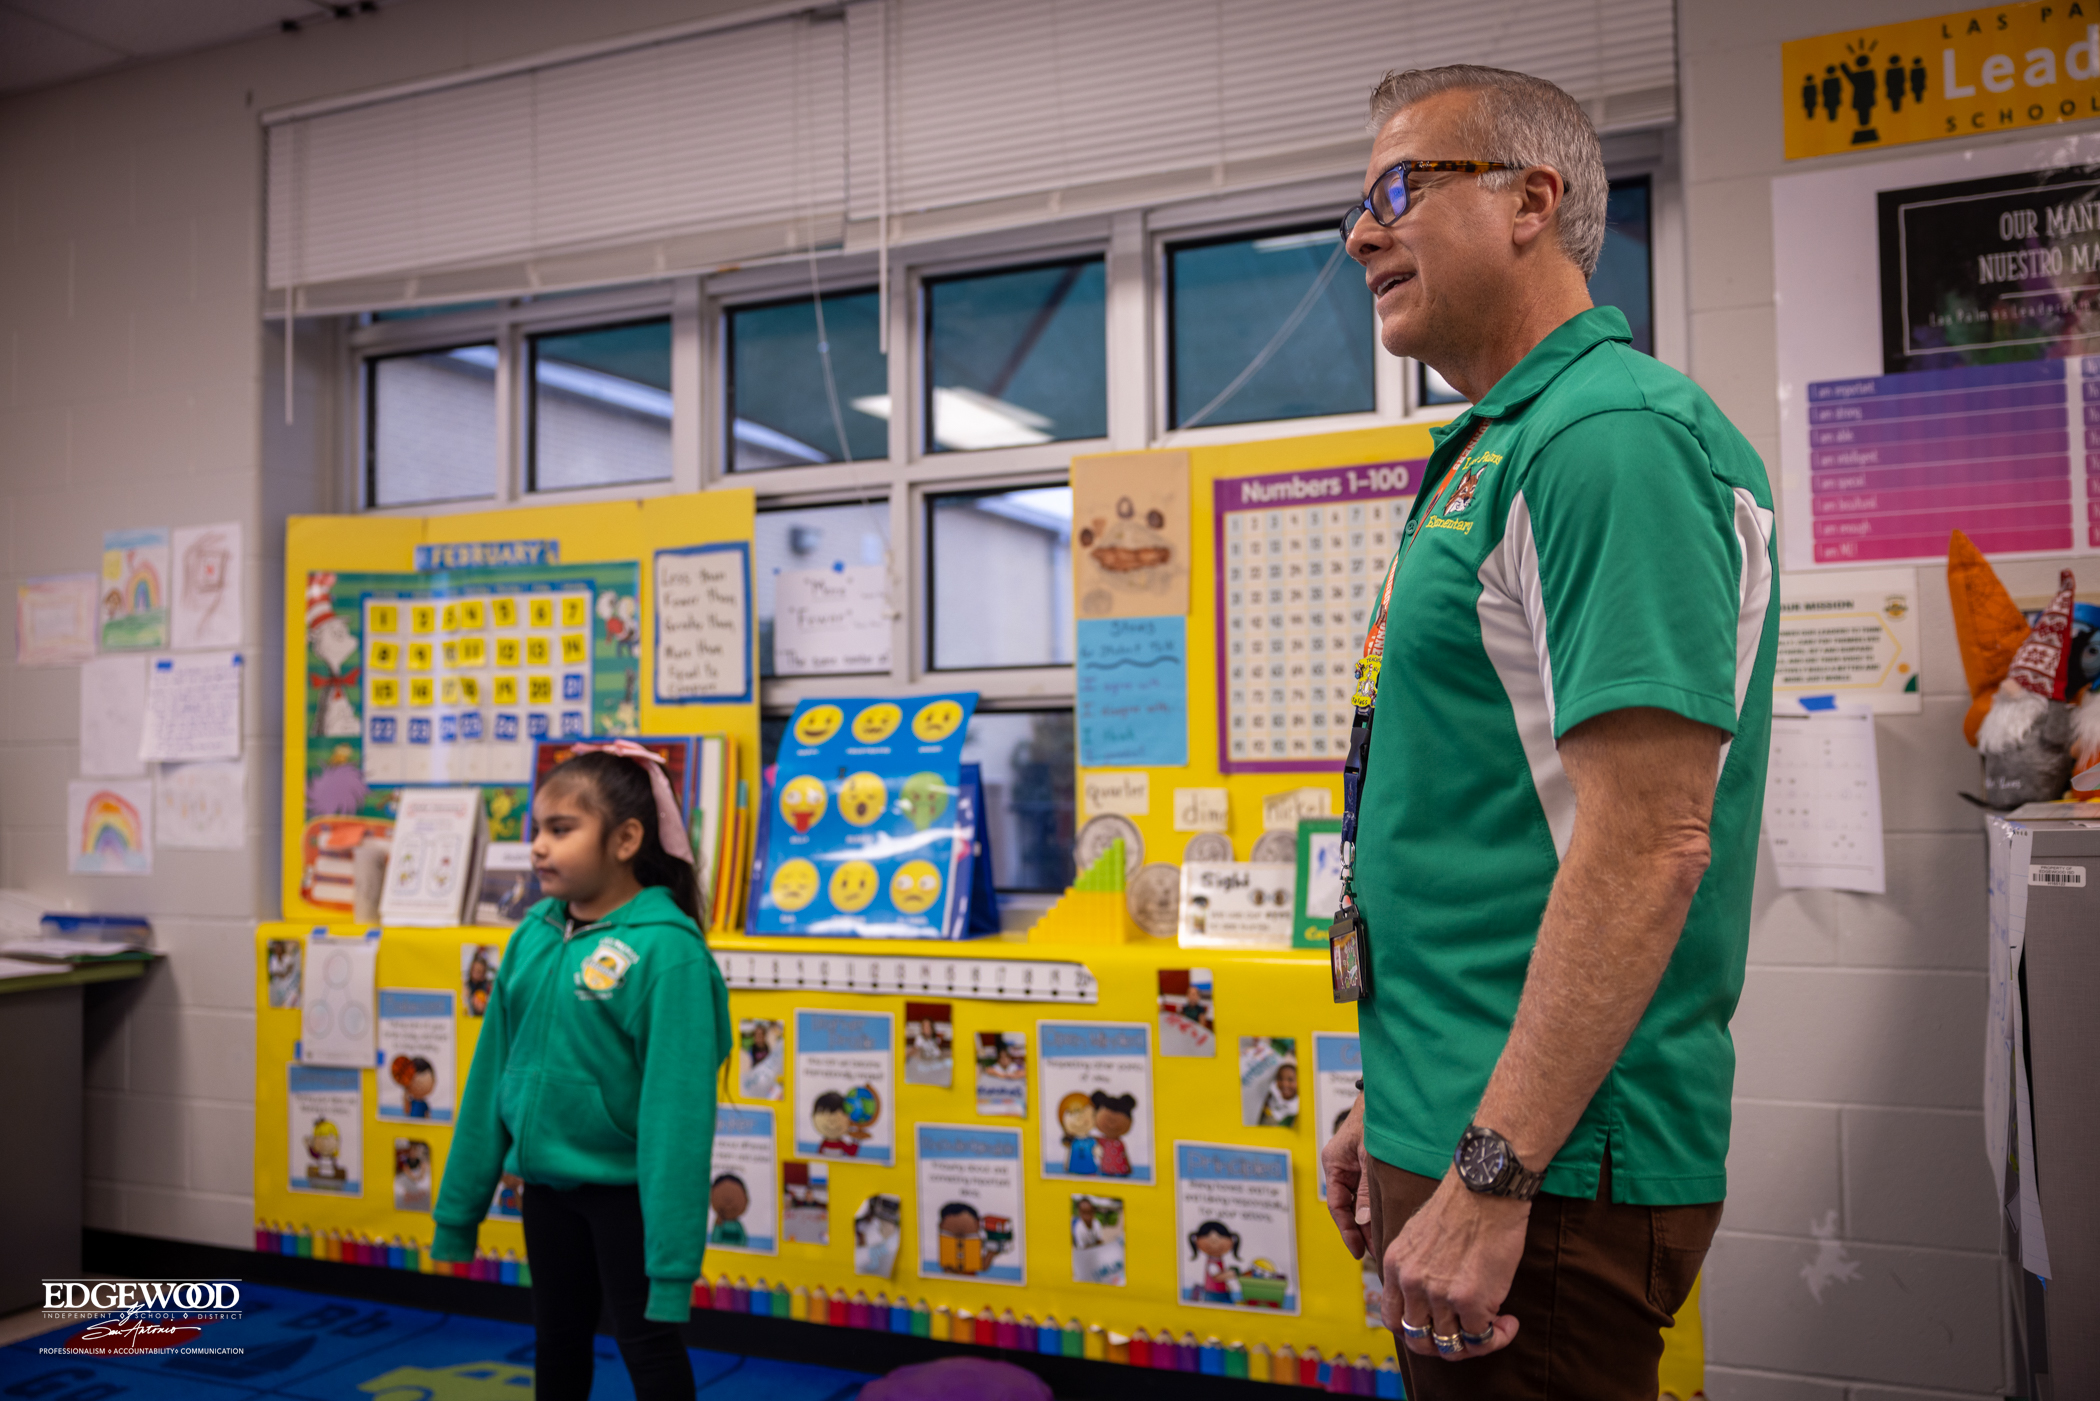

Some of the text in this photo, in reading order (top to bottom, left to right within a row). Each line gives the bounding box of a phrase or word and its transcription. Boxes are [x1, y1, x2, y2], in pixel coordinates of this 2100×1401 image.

[1941, 13, 2009, 40] LAS
[1942, 23, 2100, 100] Lead
[1999, 207, 2039, 241] OUR
[1977, 249, 2064, 285] NUESTRO
[1241, 473, 1343, 504] Numbers
